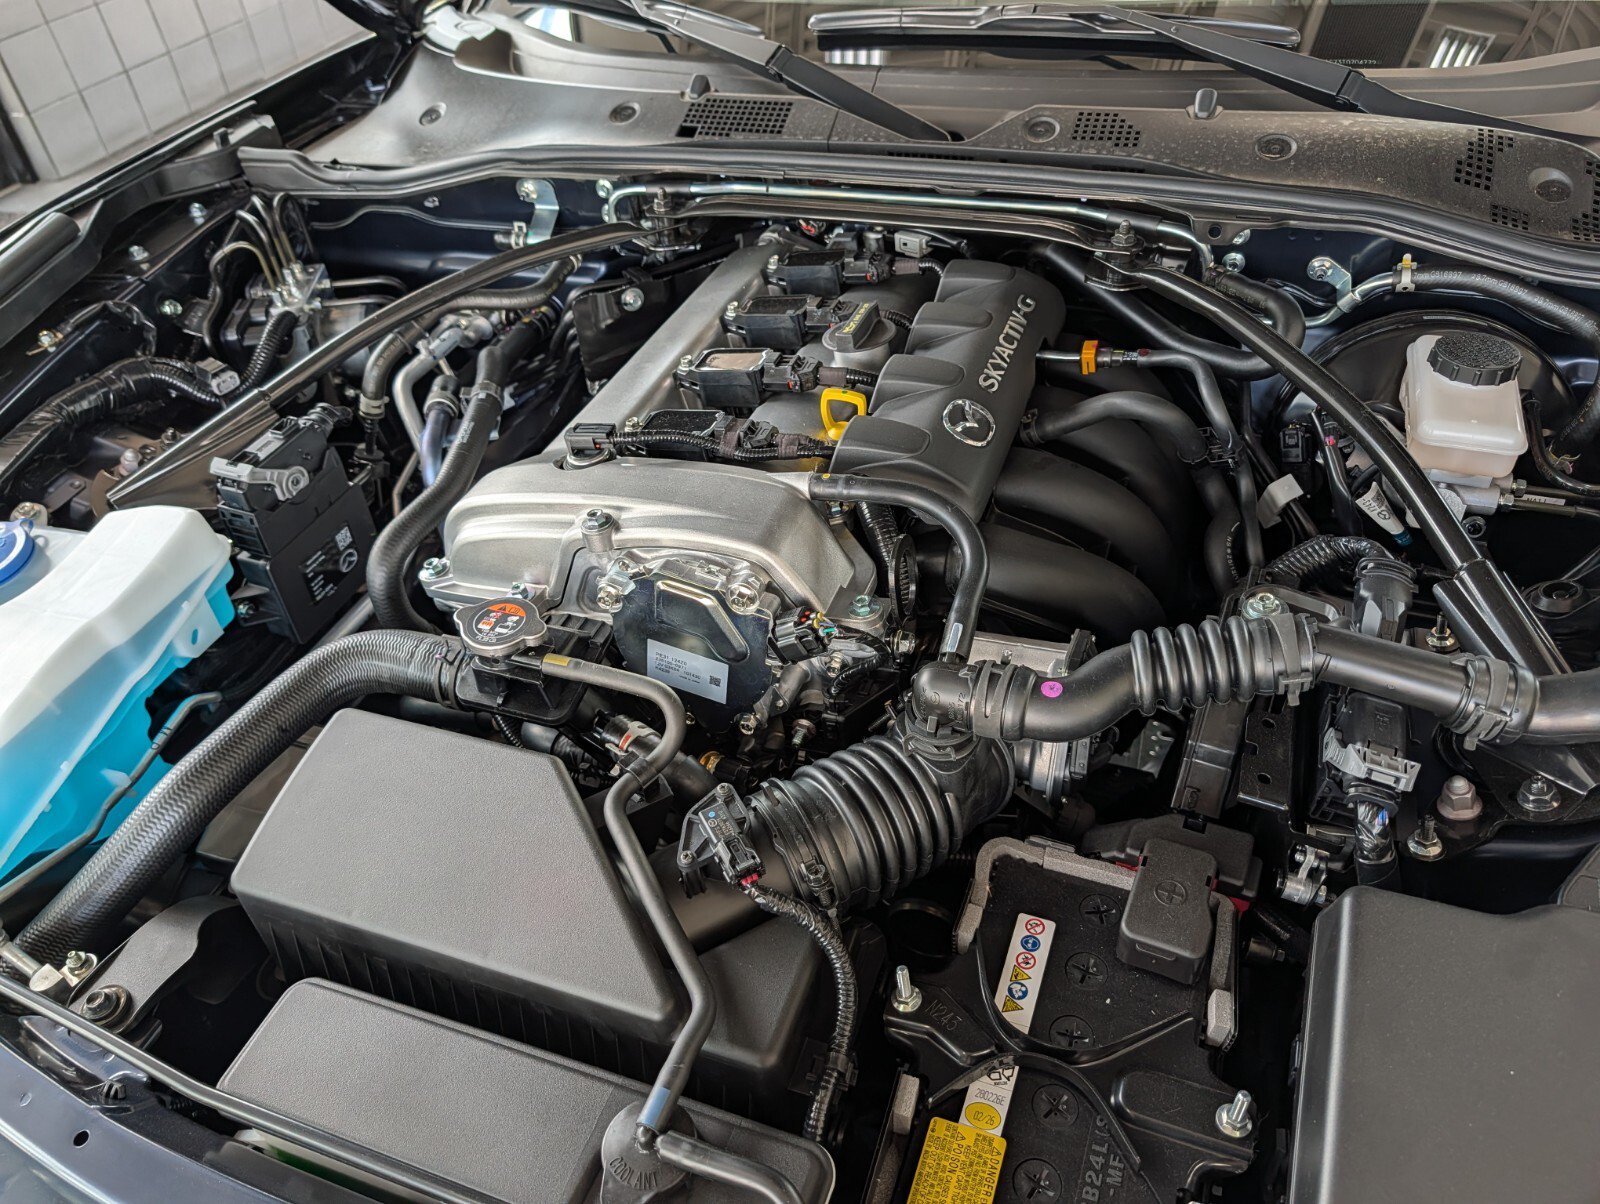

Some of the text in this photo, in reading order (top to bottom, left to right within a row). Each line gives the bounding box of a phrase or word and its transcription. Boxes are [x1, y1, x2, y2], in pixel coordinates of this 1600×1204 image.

[978, 293, 1036, 394] SKYACTIV-G
[973, 1110, 996, 1126] 02/26
[609, 1156, 658, 1190] COOLANT
[947, 1143, 964, 1175] POISON
[982, 1157, 1000, 1198] DANGER
